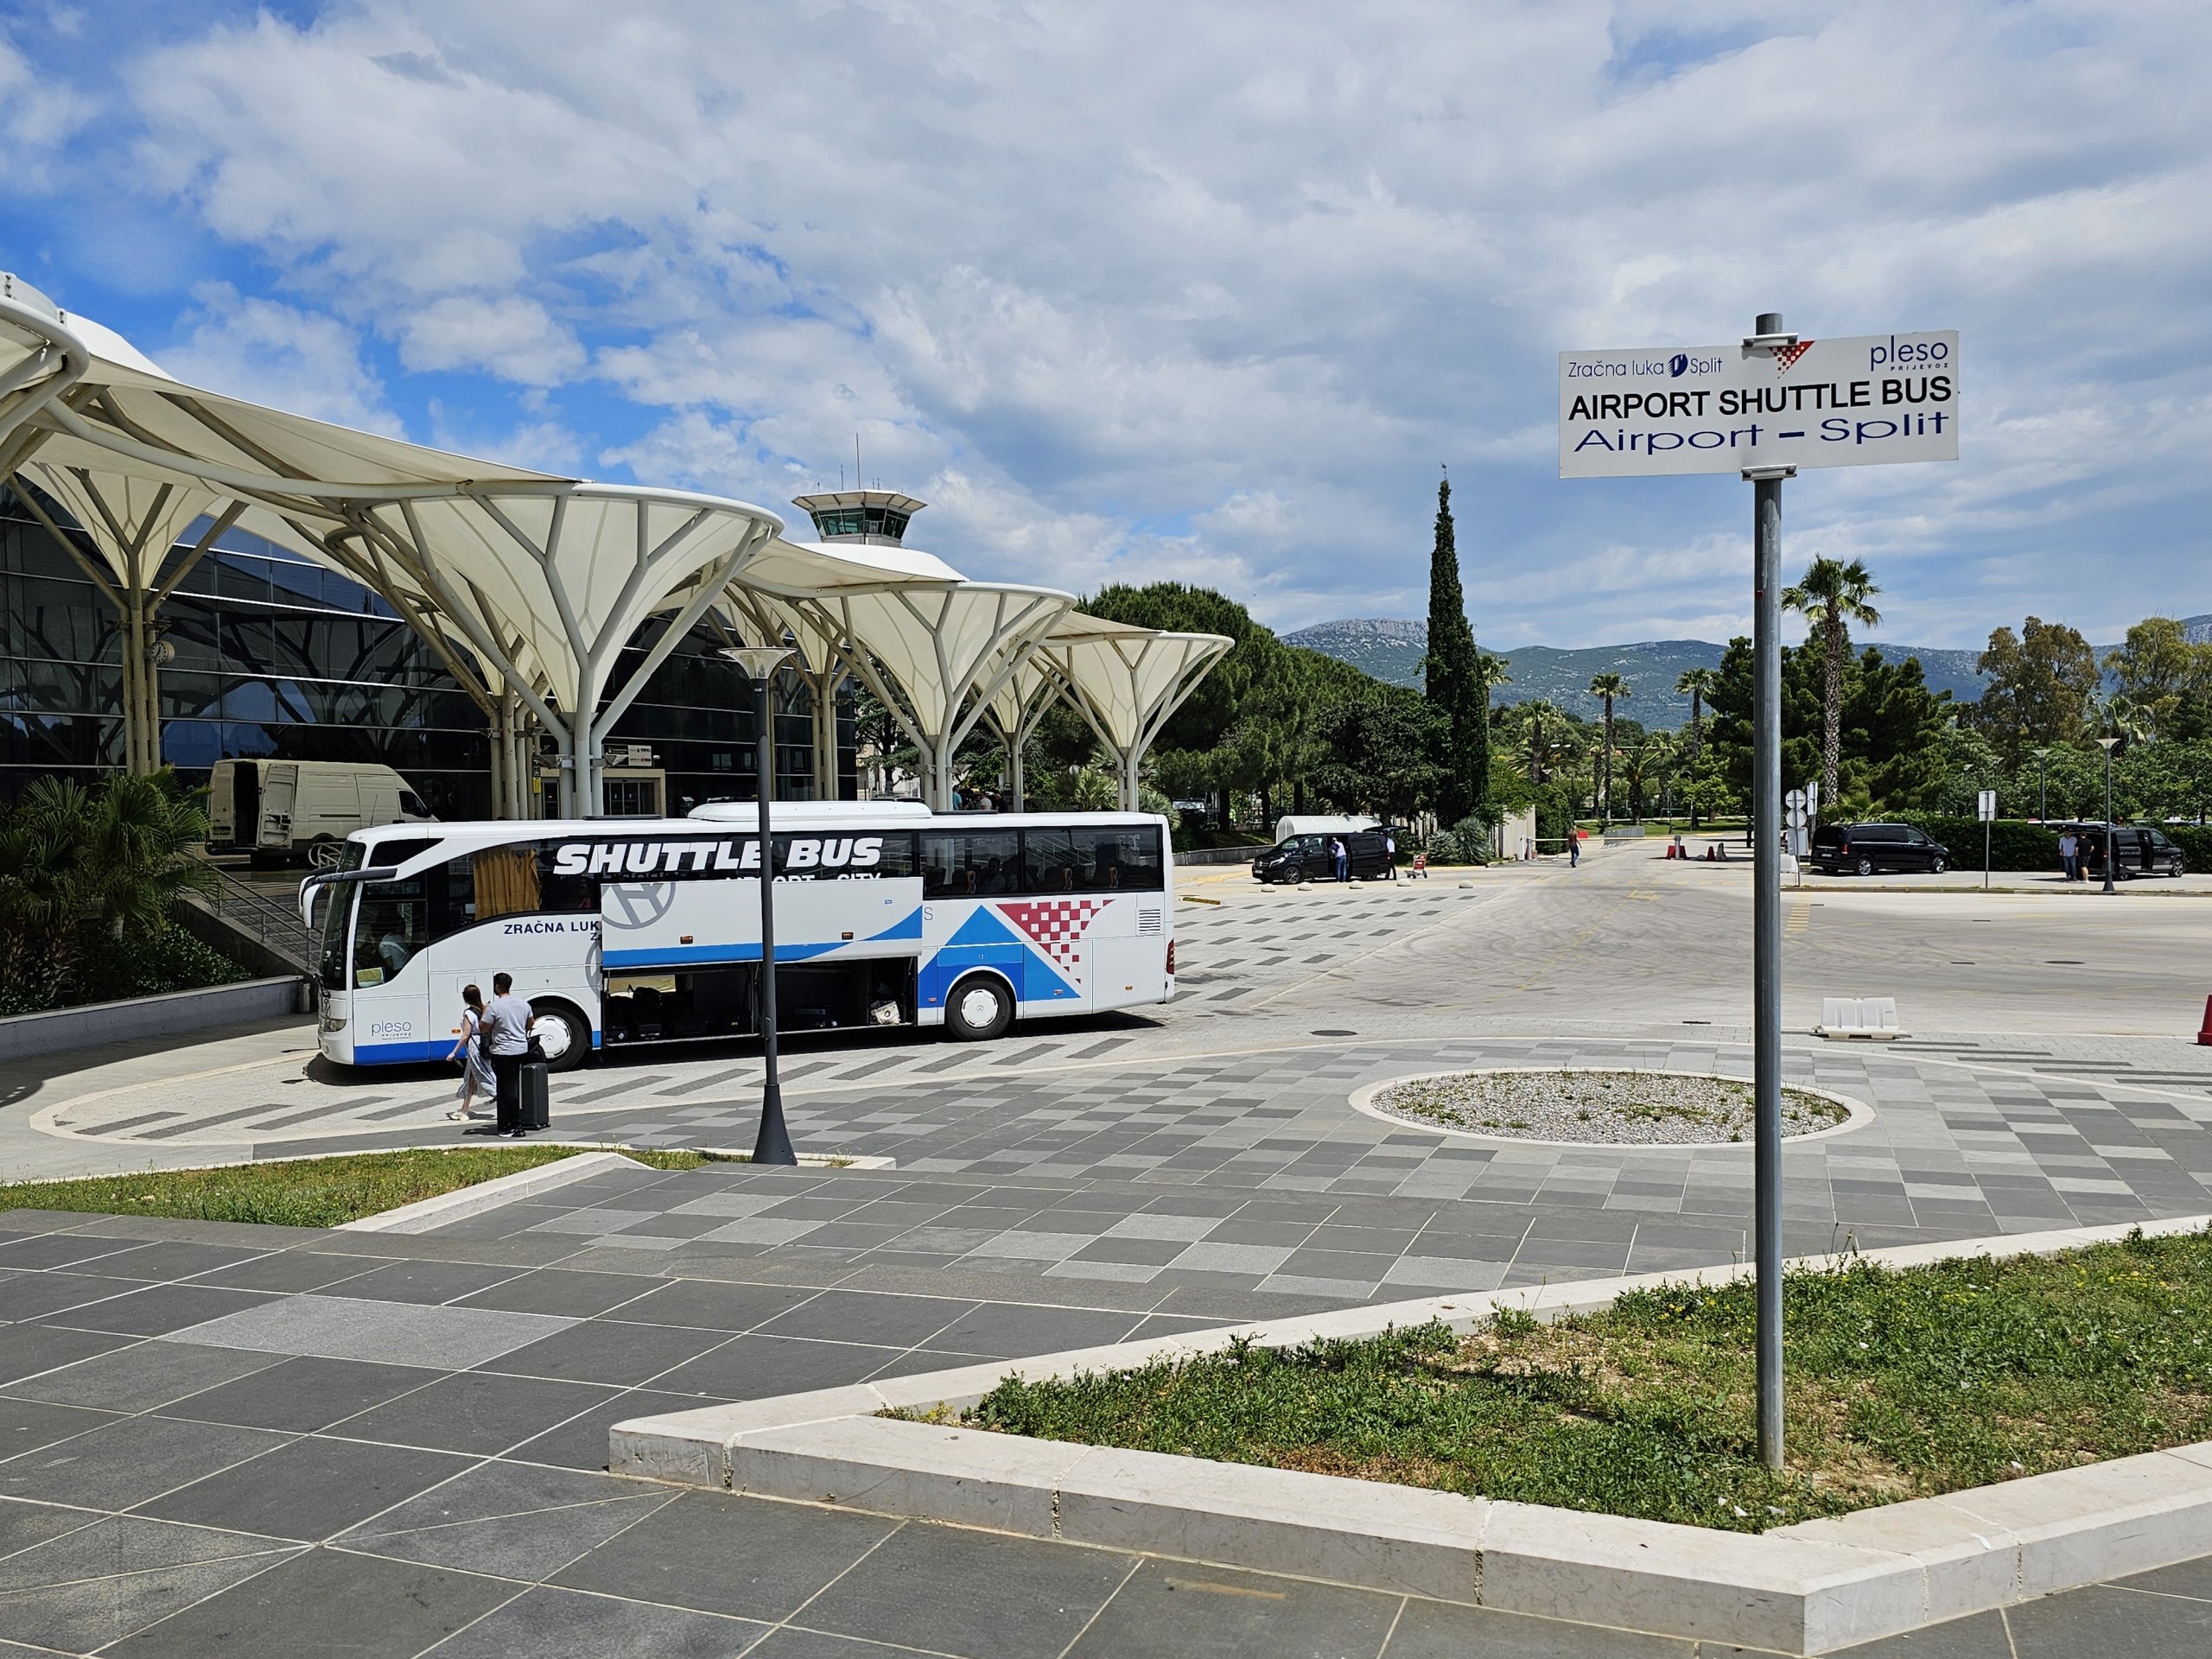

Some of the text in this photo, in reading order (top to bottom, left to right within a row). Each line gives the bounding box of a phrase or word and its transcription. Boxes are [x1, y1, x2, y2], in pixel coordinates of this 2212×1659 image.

[1567, 357, 1723, 378] Zračna luka Split
[1871, 335, 1948, 372] pleso
[1890, 363, 1948, 372] PRIJEVOZ
[1568, 375, 1952, 421] AIRPORT SHUTTLE BUS
[1573, 424, 1764, 455] Airport
[1820, 411, 1949, 445] Split
[553, 837, 883, 874] SHUTTLE BUS
[504, 920, 602, 934] ZRAČNA LUK
[372, 1020, 412, 1036] pleso
